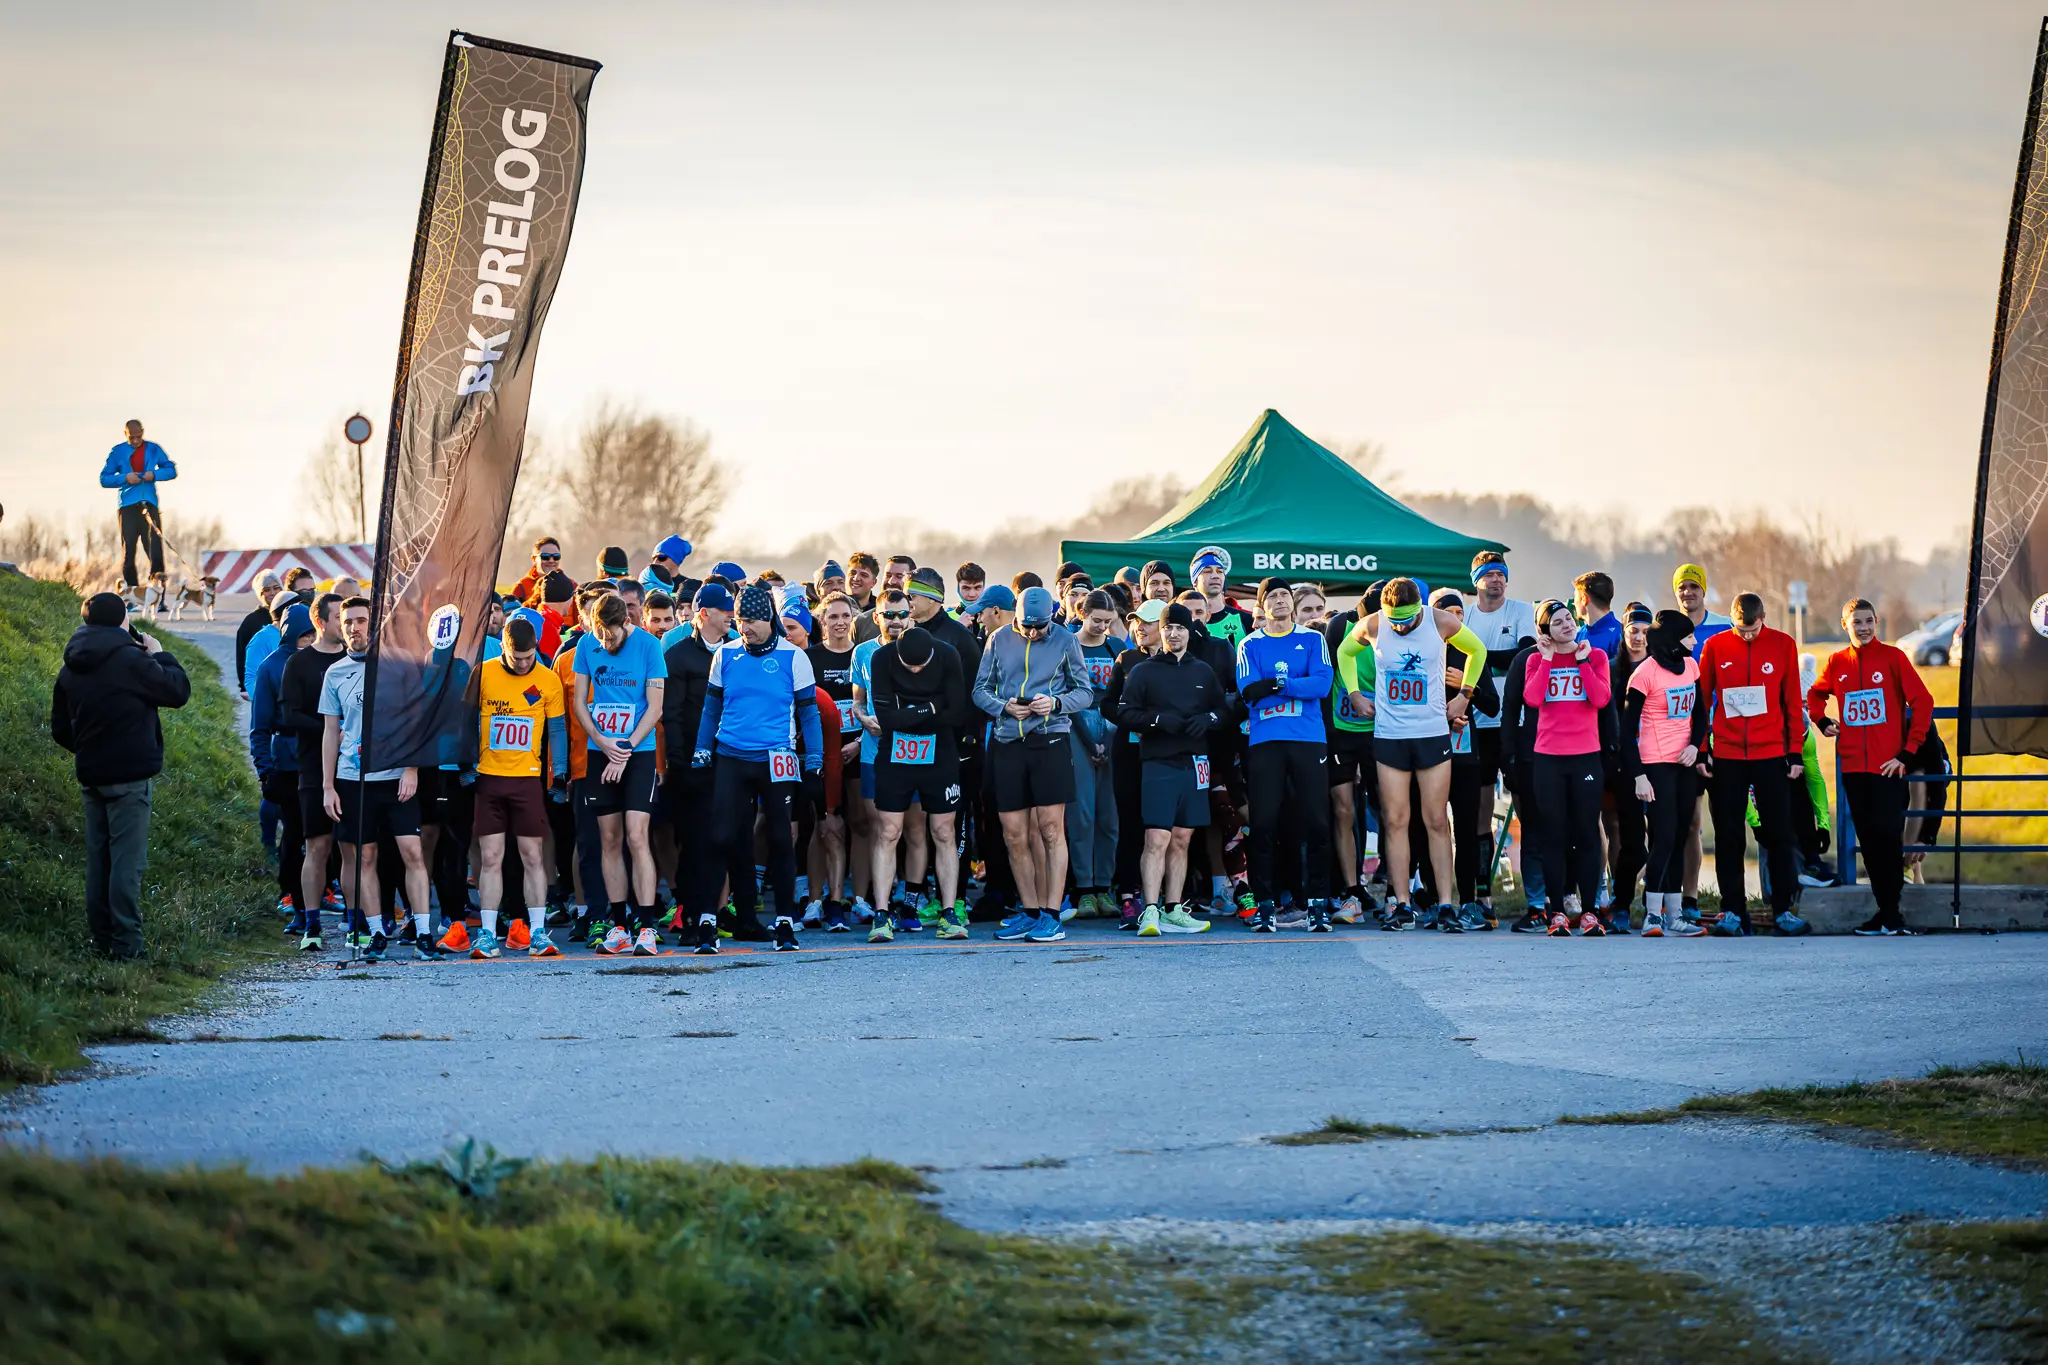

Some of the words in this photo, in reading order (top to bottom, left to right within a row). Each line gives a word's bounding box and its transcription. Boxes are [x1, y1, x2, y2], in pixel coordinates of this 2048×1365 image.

[472, 107, 547, 321] PRELOG
[458, 323, 511, 395] BK
[1253, 553, 1285, 570] BK
[1290, 553, 1378, 571] PRELOG
[600, 677, 623, 687] WORLD
[623, 679, 637, 688] RUN
[1085, 664, 1113, 686] 38
[1548, 675, 1583, 697] 679
[1388, 678, 1423, 702] 690
[487, 699, 510, 708] SWIM
[1847, 698, 1881, 722] 593
[597, 712, 631, 734] 847
[494, 723, 528, 747] 700
[895, 739, 931, 760] 397
